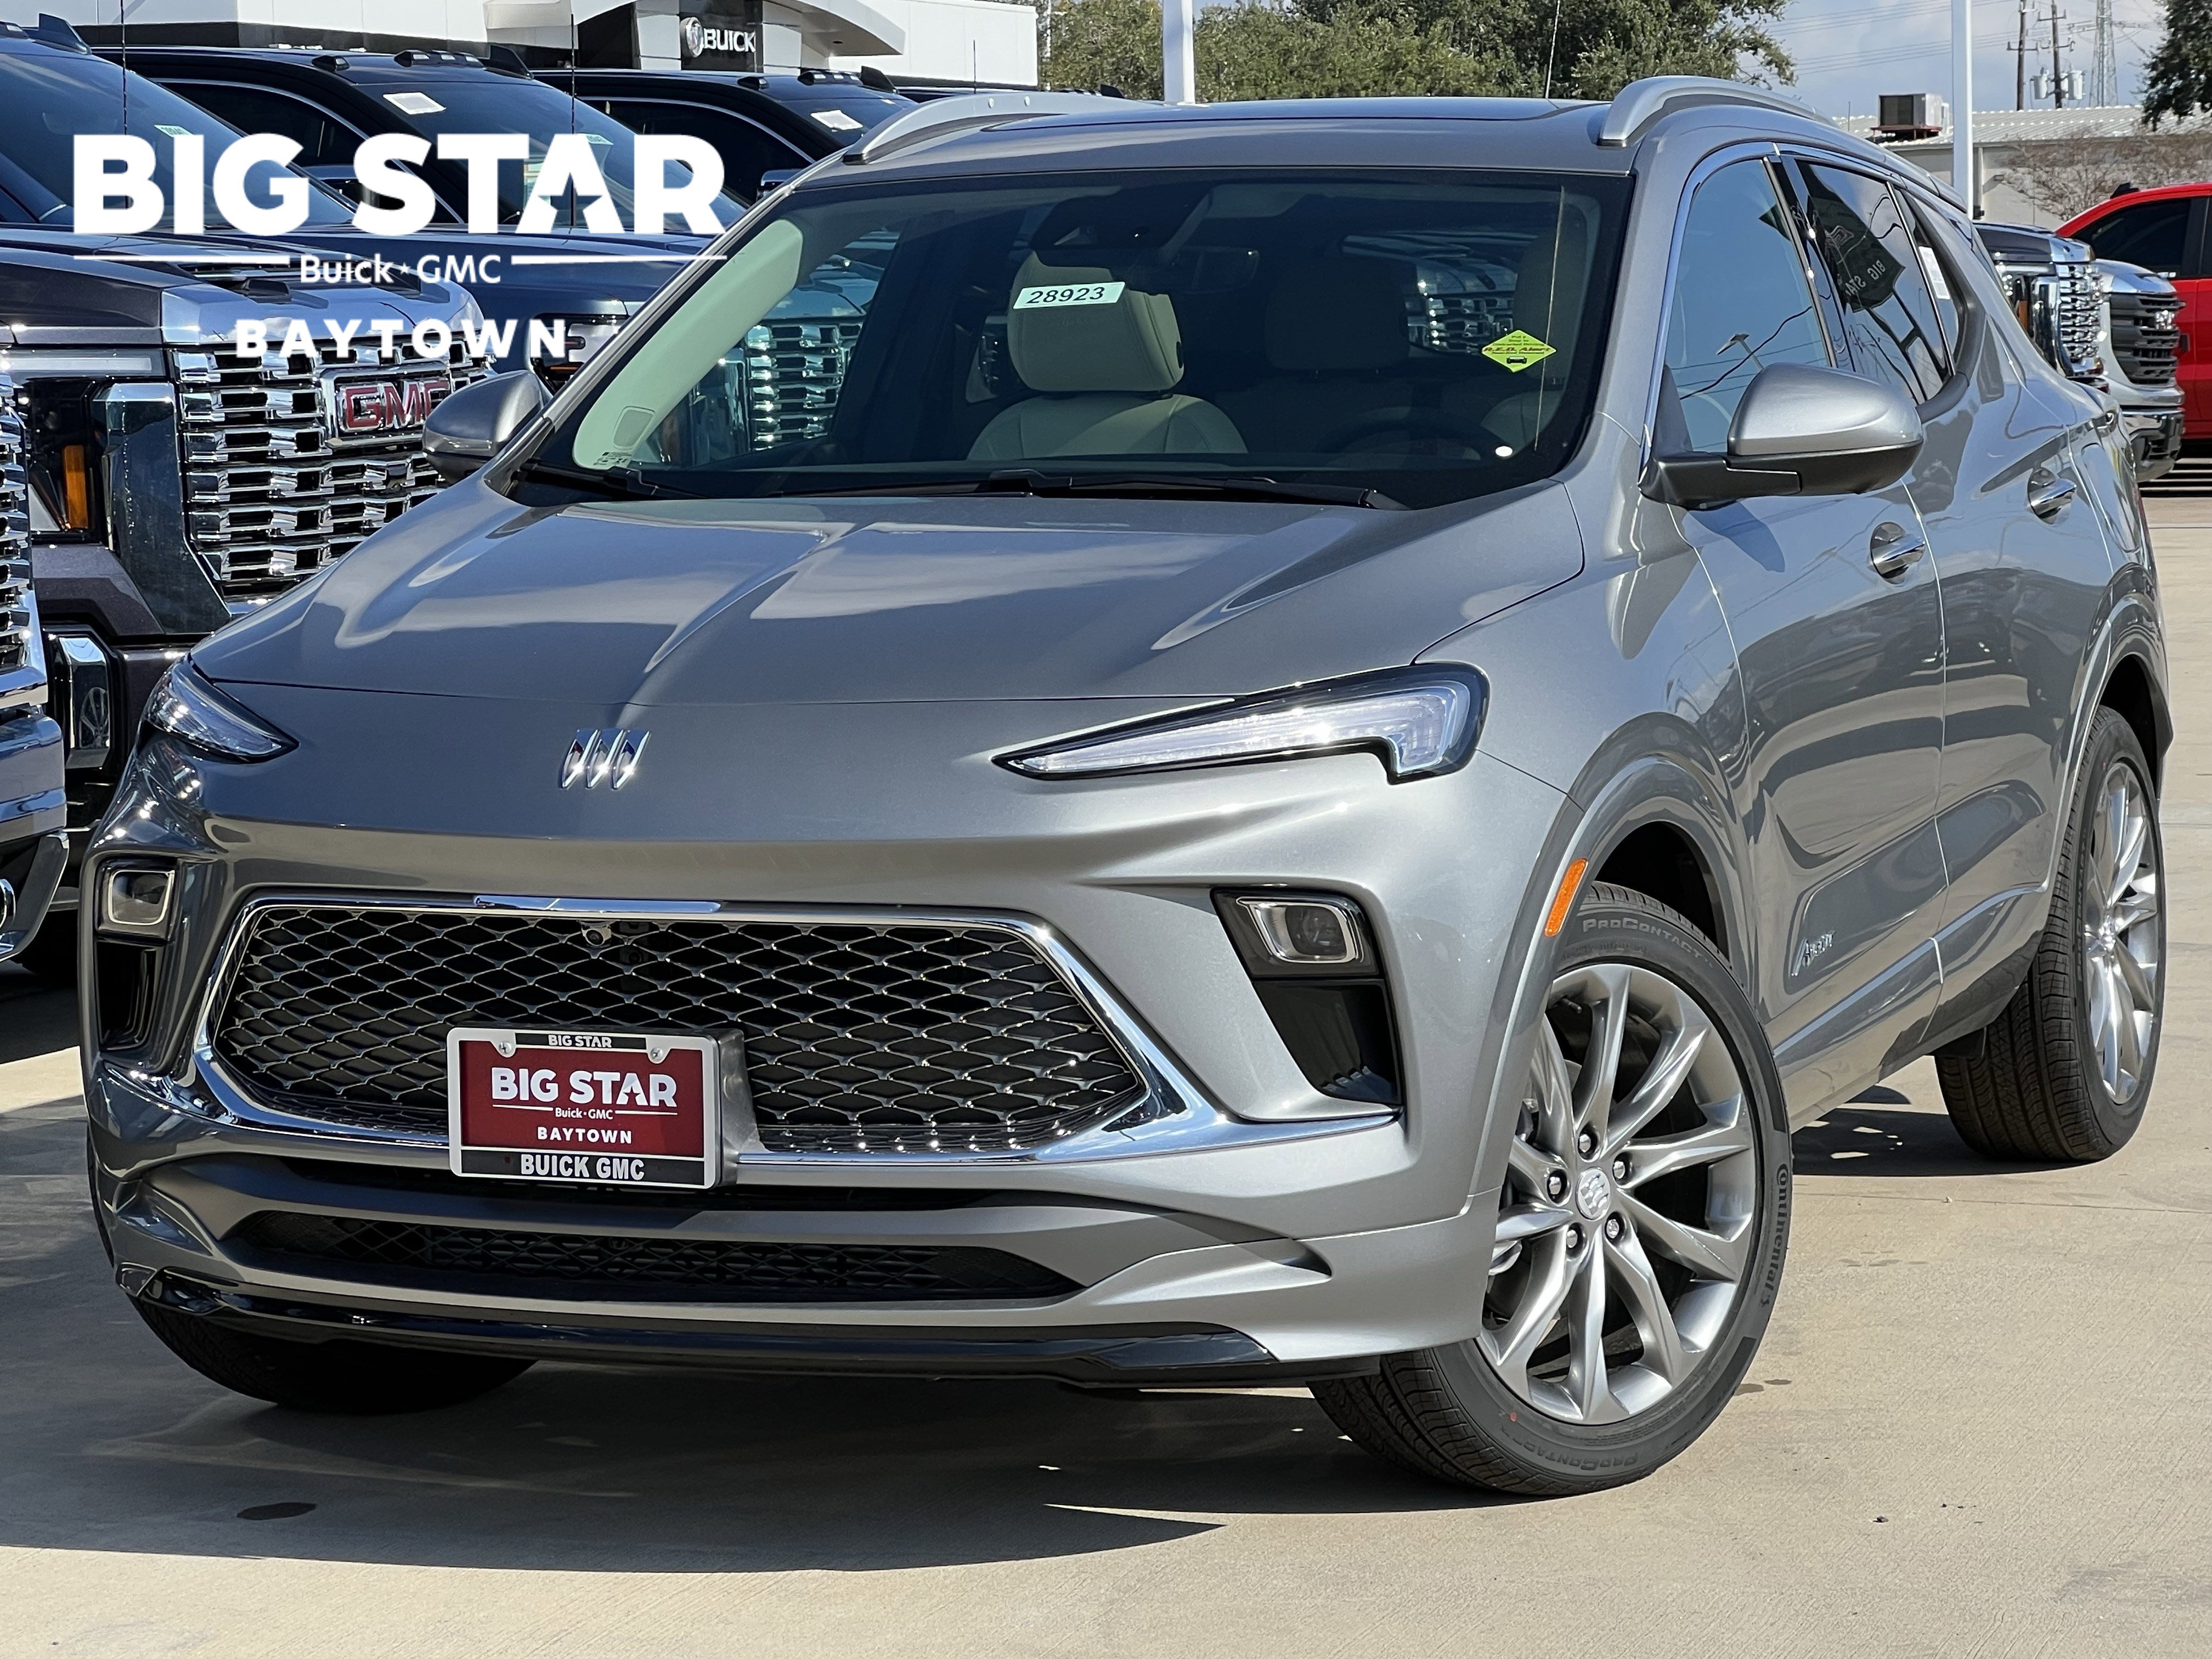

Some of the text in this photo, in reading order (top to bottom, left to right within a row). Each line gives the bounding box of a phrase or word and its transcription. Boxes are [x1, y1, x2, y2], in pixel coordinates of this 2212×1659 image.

[703, 27, 756, 53] BUICK
[1026, 286, 1105, 304] 28923
[337, 379, 450, 432] GMC
[548, 1034, 612, 1048] BIG STAR
[491, 1067, 678, 1108] BIG STAR
[555, 1107, 614, 1120] Buick GMC
[537, 1126, 632, 1144] BAYTOWN
[521, 1154, 645, 1181] BUICK GMC
[1765, 1164, 1789, 1291] Continental
